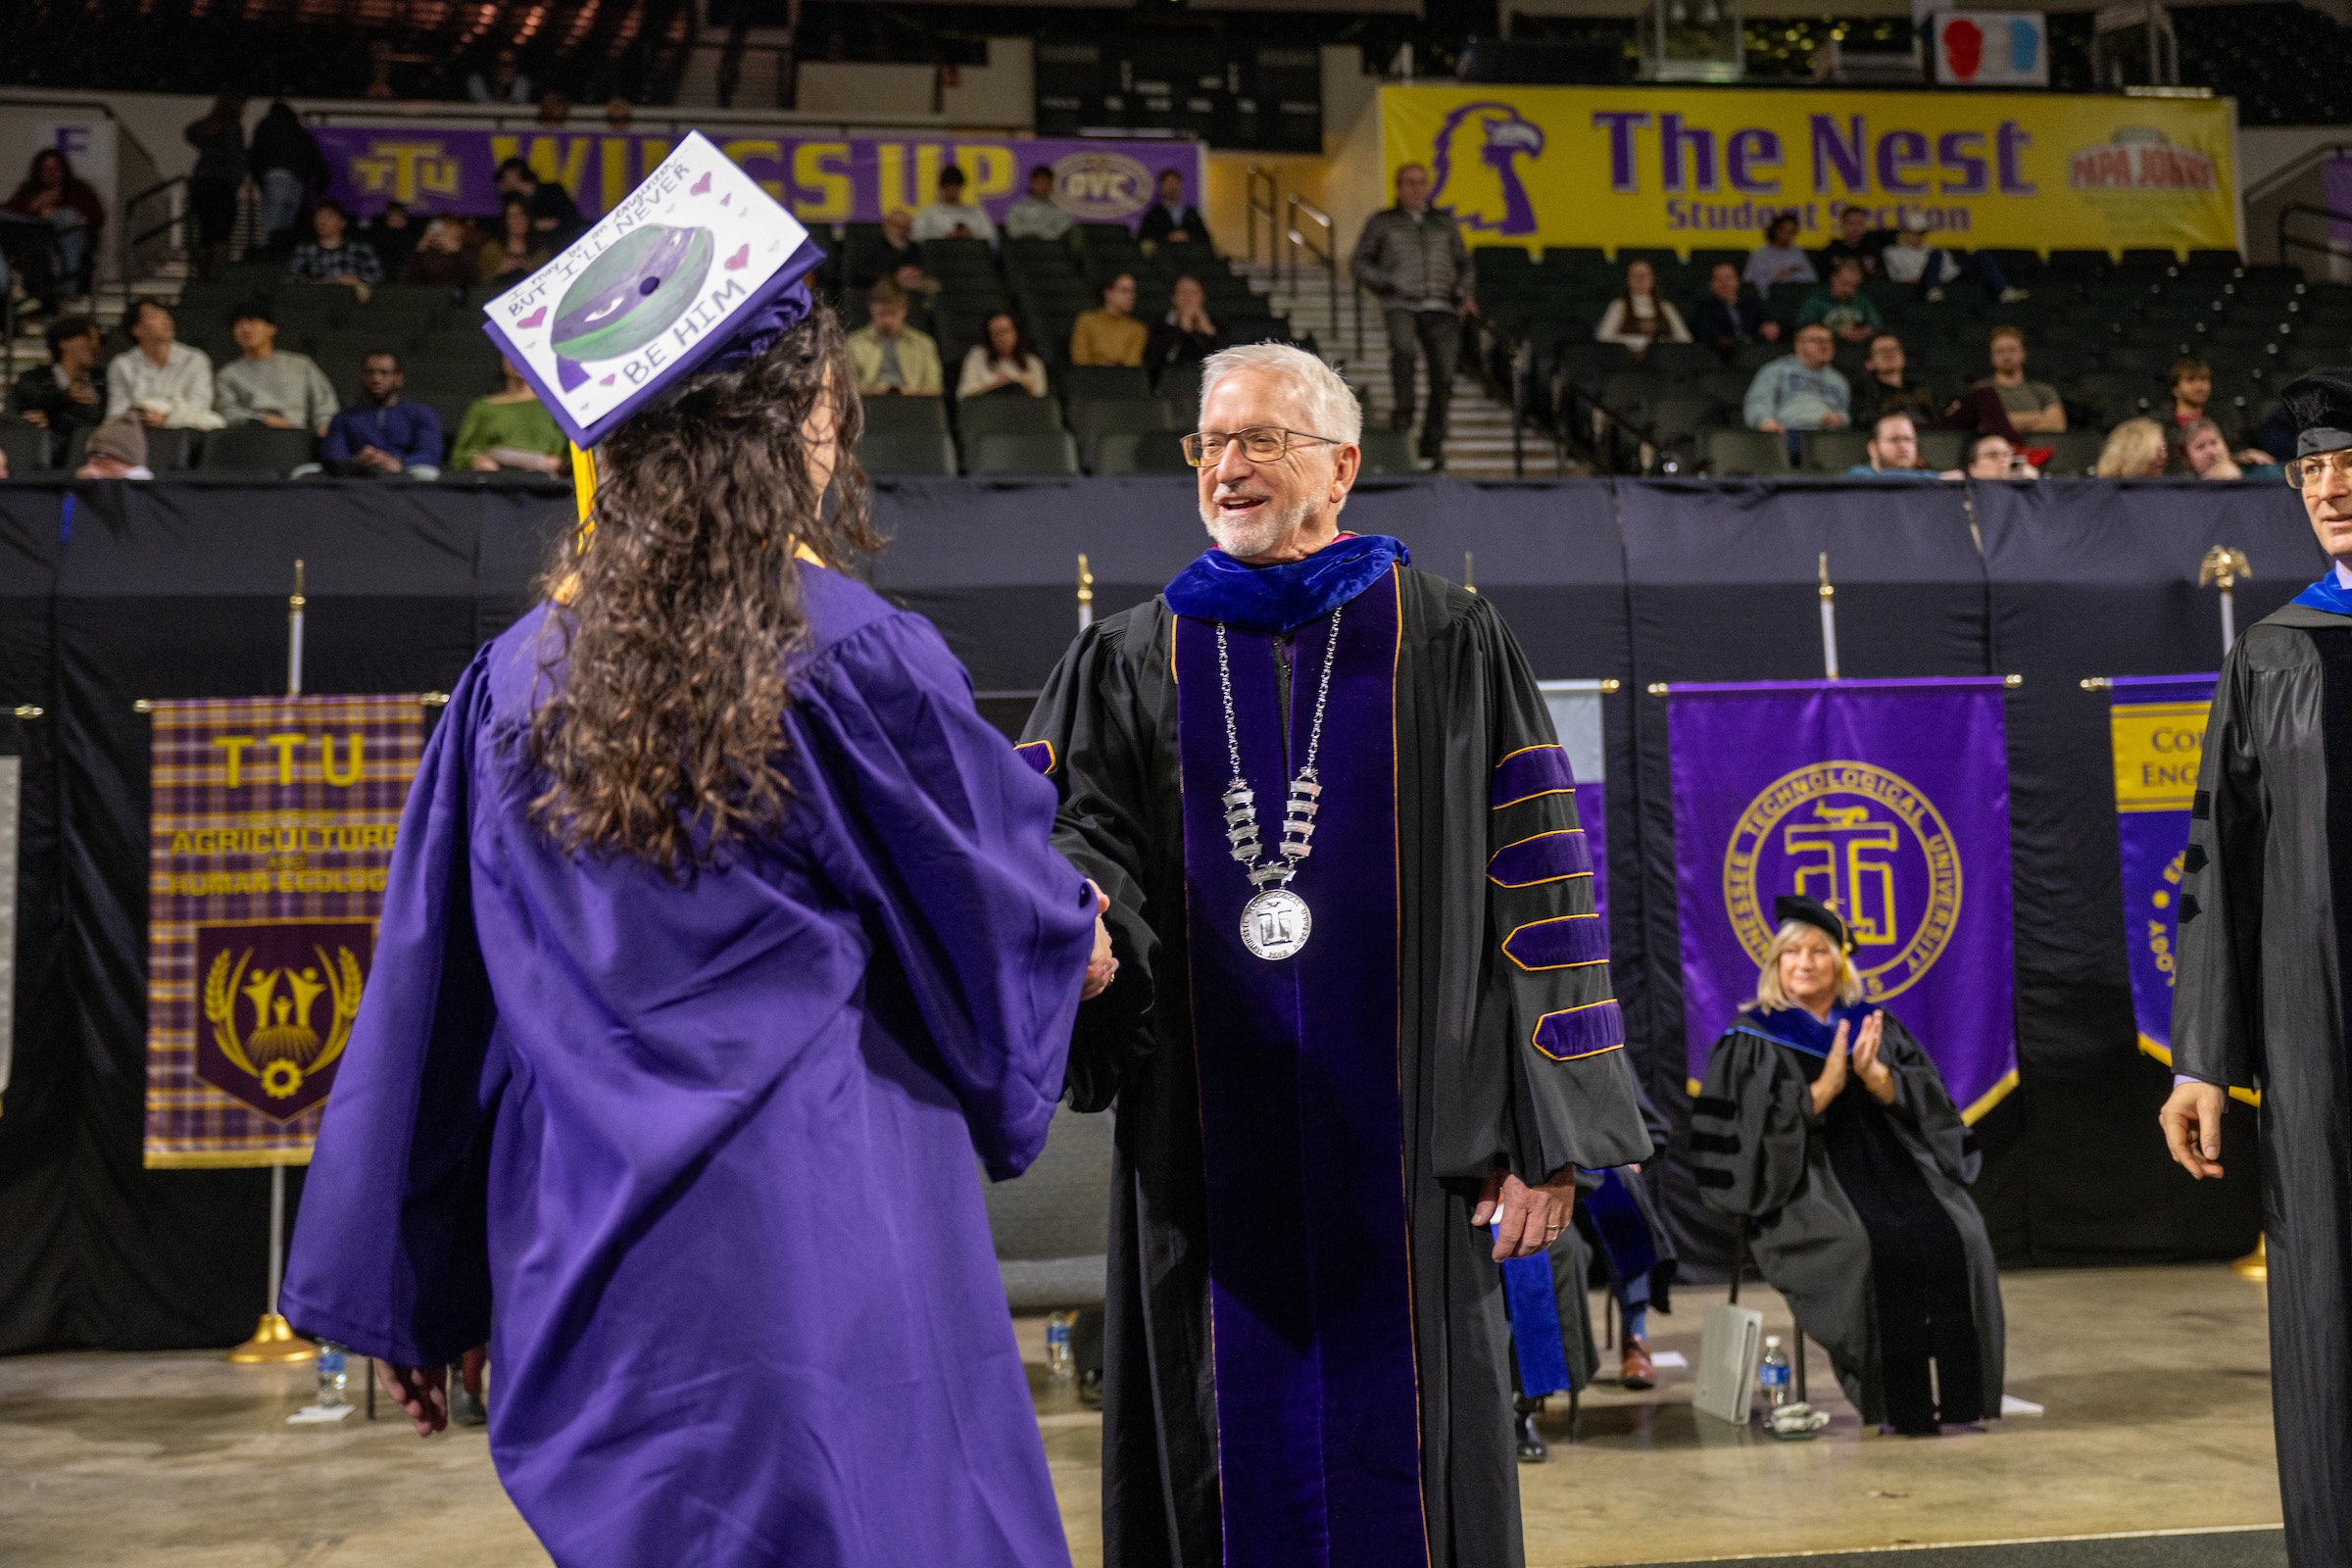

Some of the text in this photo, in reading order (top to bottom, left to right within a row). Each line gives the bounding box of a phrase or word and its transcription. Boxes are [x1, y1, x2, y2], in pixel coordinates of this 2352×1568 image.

[875, 143, 1015, 218] UP
[1591, 111, 2036, 197] The Nest
[508, 164, 690, 318] BUT I'LL NEVER
[531, 263, 561, 286] may
[591, 224, 609, 240] an
[622, 277, 748, 386] BE HIM
[278, 867, 388, 893] ECOLOG
[1744, 767, 1927, 836] TECHNOLOGICAL
[1906, 833, 1953, 974] UNIVERSITY
